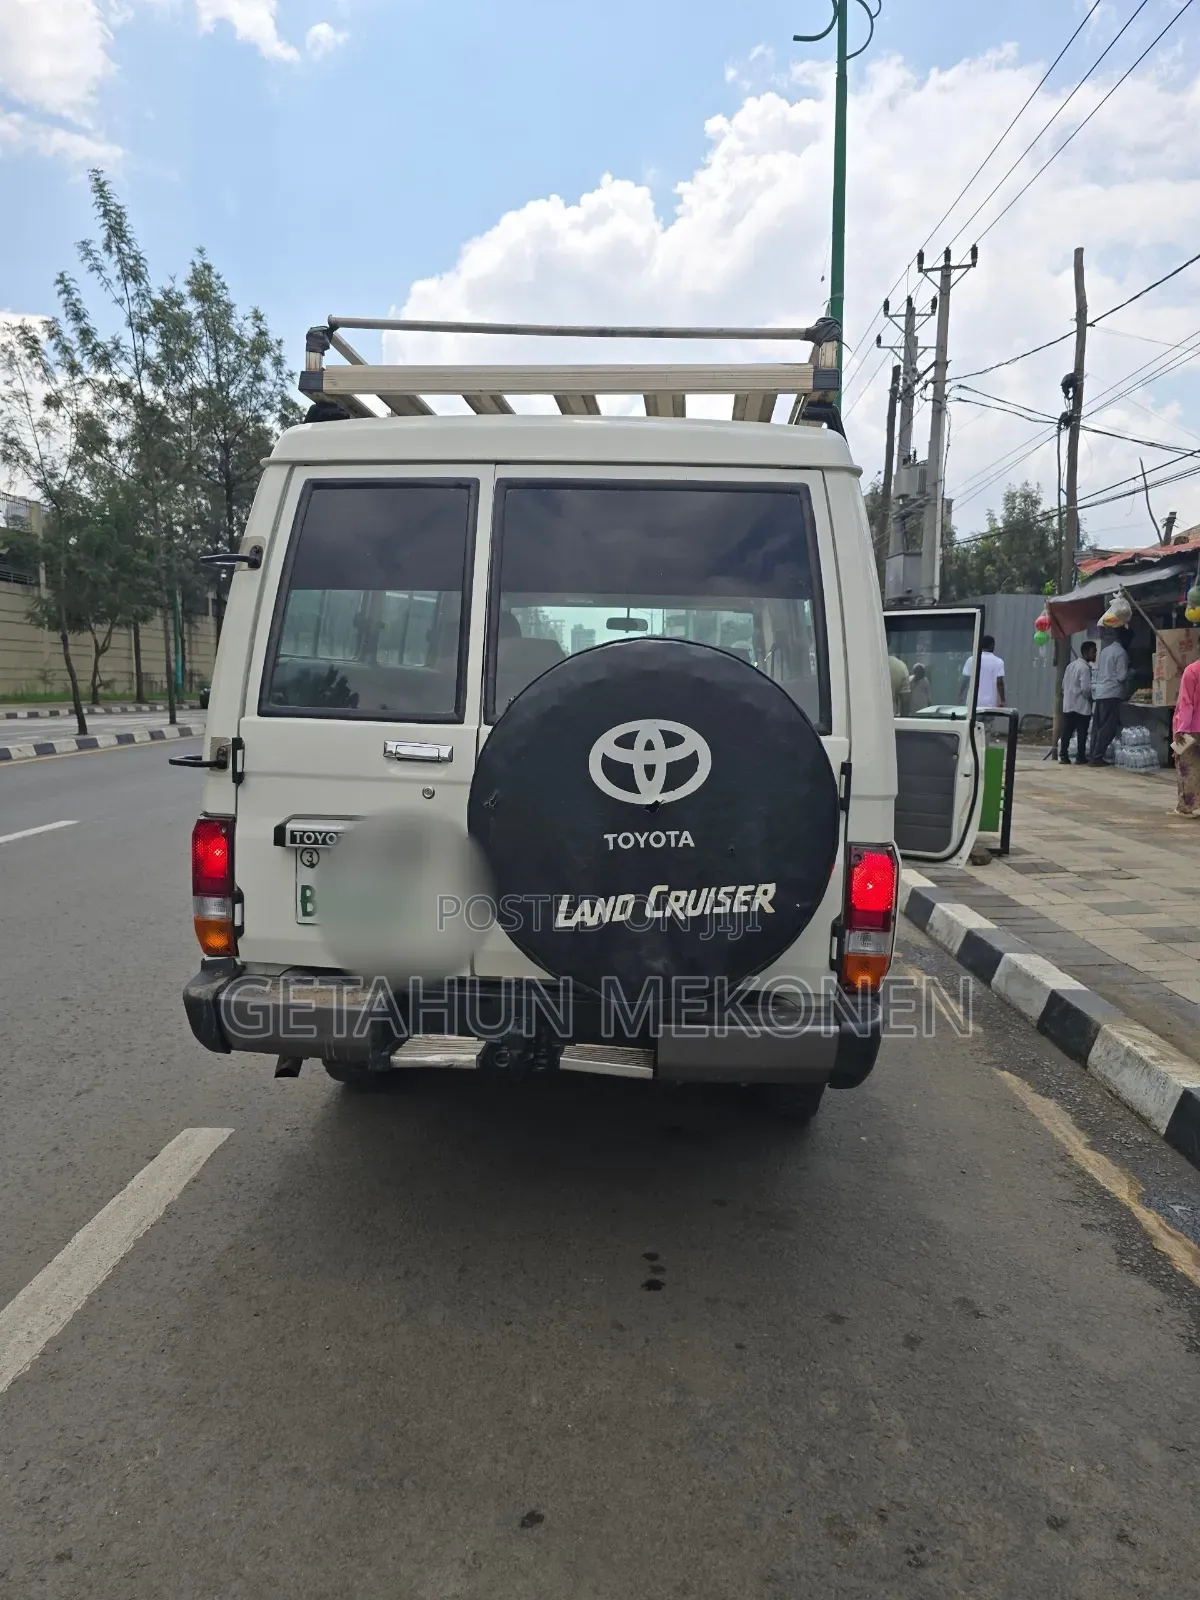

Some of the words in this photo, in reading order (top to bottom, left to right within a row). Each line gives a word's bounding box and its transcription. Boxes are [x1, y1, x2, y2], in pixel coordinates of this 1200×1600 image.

[293, 831, 345, 845] TOYO
[603, 831, 696, 851] TOYOTA
[555, 893, 636, 928] LAND
[645, 882, 776, 920] CRUISER
